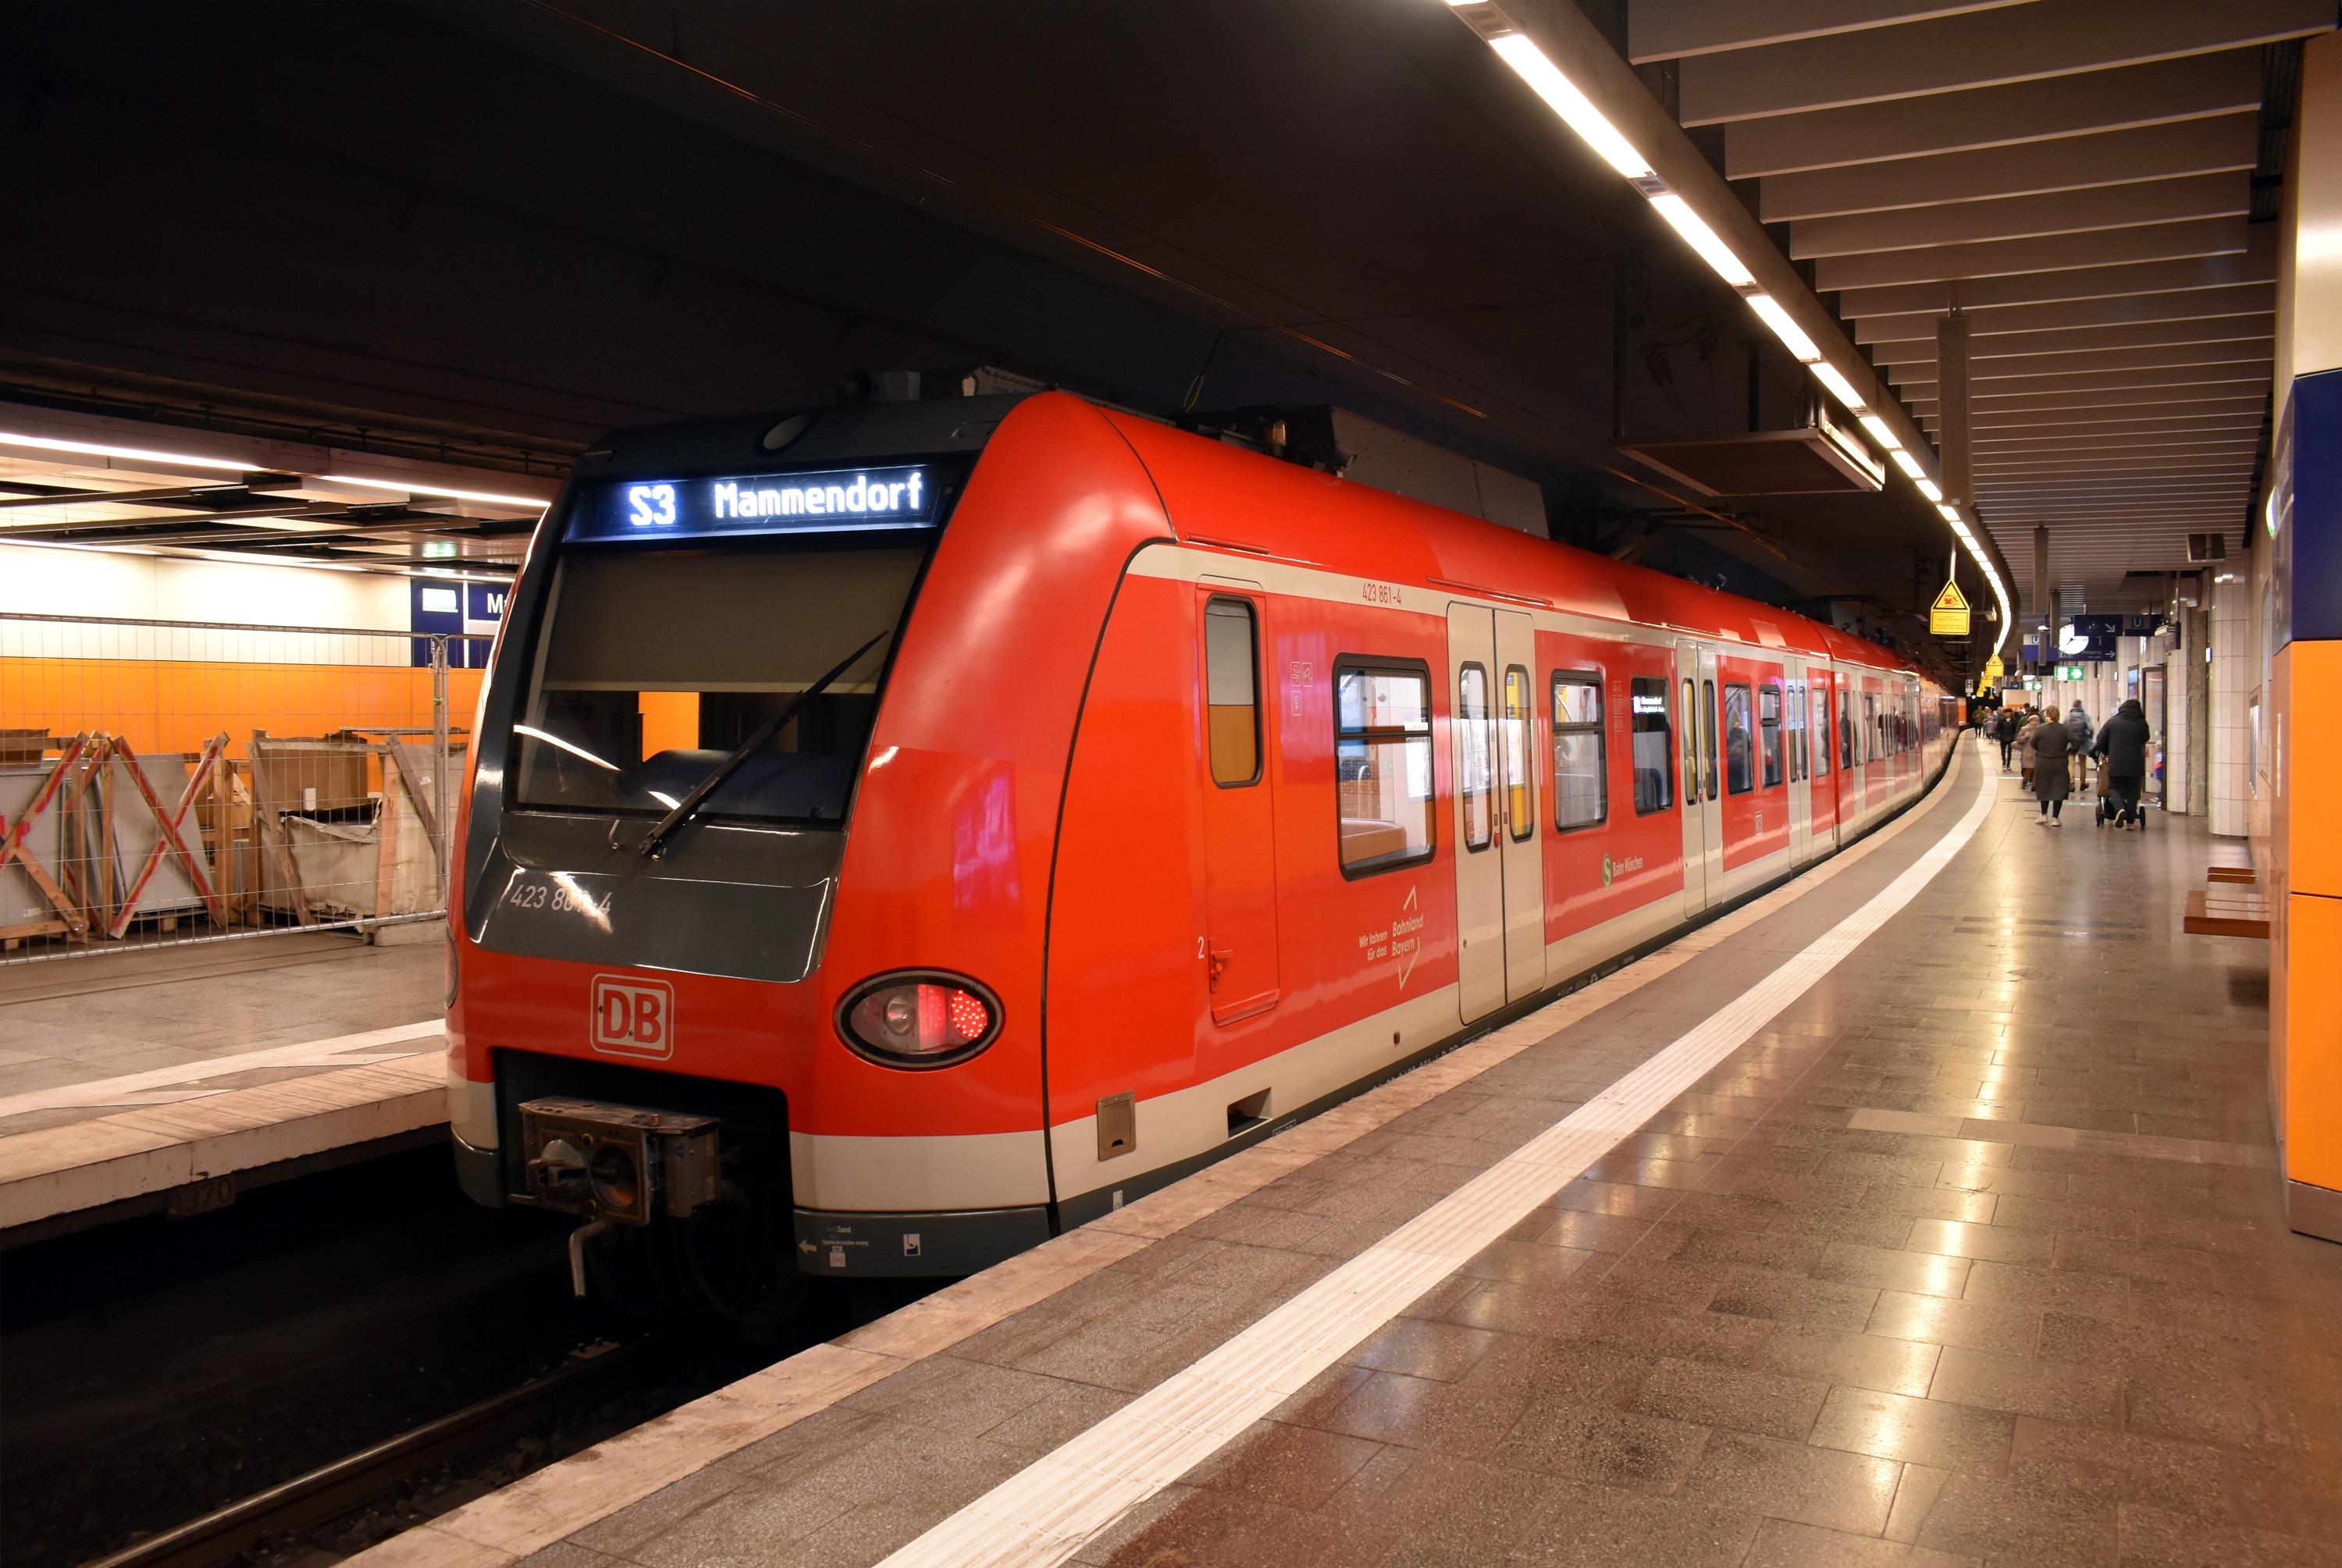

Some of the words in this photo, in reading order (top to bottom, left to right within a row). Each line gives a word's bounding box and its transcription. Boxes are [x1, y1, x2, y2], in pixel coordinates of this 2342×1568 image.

[629, 484, 676, 526] S3
[714, 471, 923, 519] Mammendorf
[1362, 582, 1377, 602] 423
[1379, 585, 1402, 606] 861-4
[2133, 617, 2142, 628] U
[1612, 860, 1625, 877] Bahn
[1625, 855, 1643, 873] München
[510, 884, 547, 908] 423
[1392, 912, 1424, 937] Bahnland
[1198, 936, 1205, 959] 2
[1359, 934, 1369, 948] Wir
[1369, 930, 1388, 946] fahren
[1391, 937, 1415, 957] Bayern
[1367, 948, 1376, 962] für
[1376, 944, 1387, 958] das
[600, 986, 664, 1047] DB
